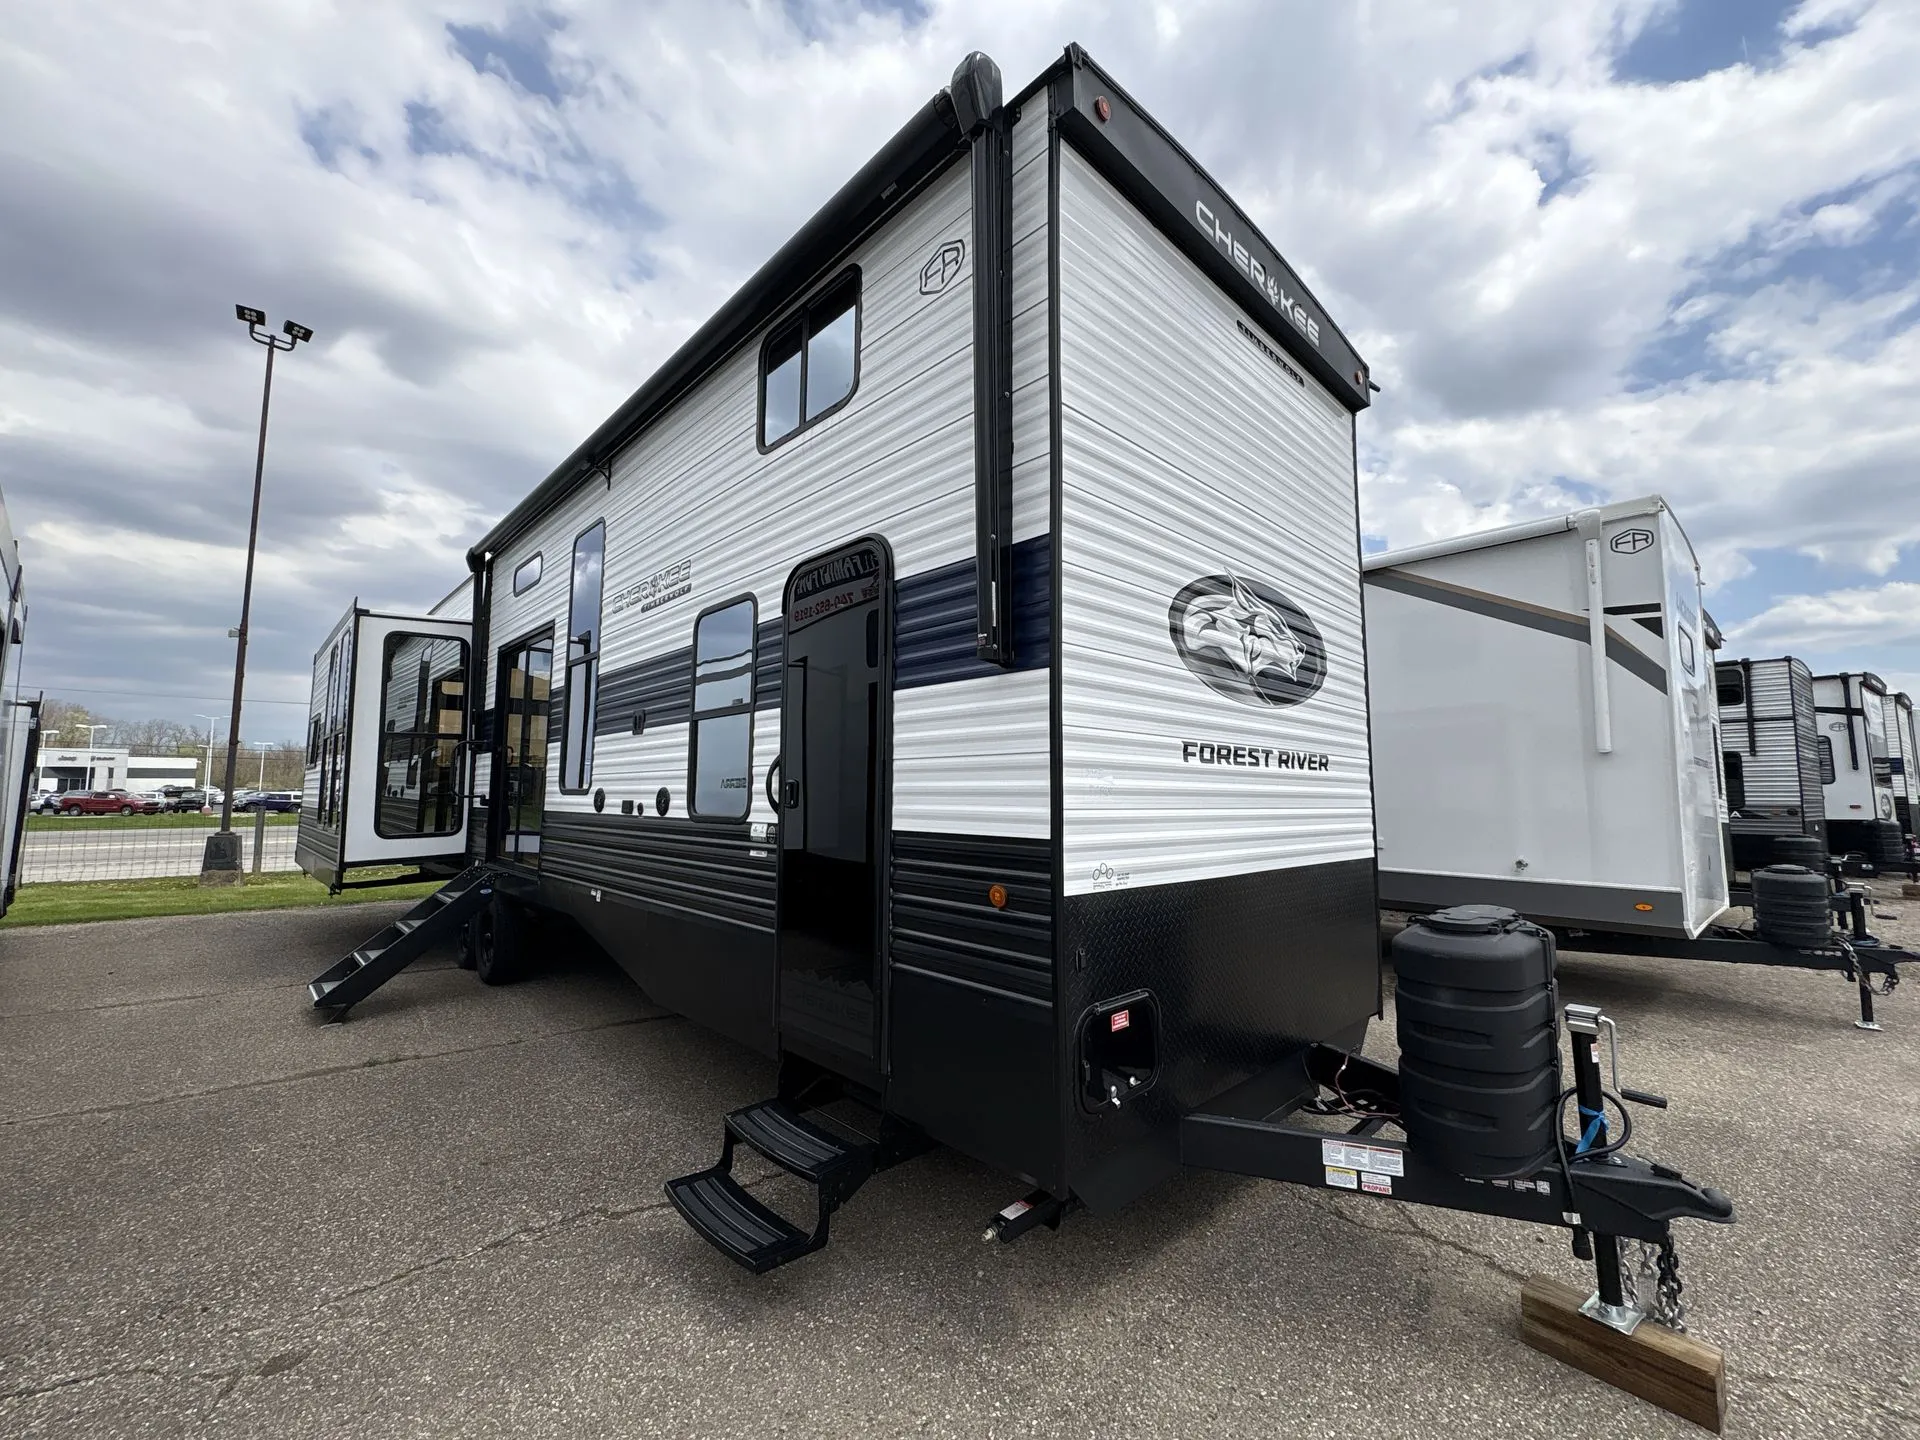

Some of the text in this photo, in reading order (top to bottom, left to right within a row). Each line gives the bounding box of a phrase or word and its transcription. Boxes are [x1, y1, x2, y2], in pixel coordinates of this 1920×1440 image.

[1181, 741, 1329, 771] FOREST RIVER
[1363, 1184, 1390, 1193] PROPANE
